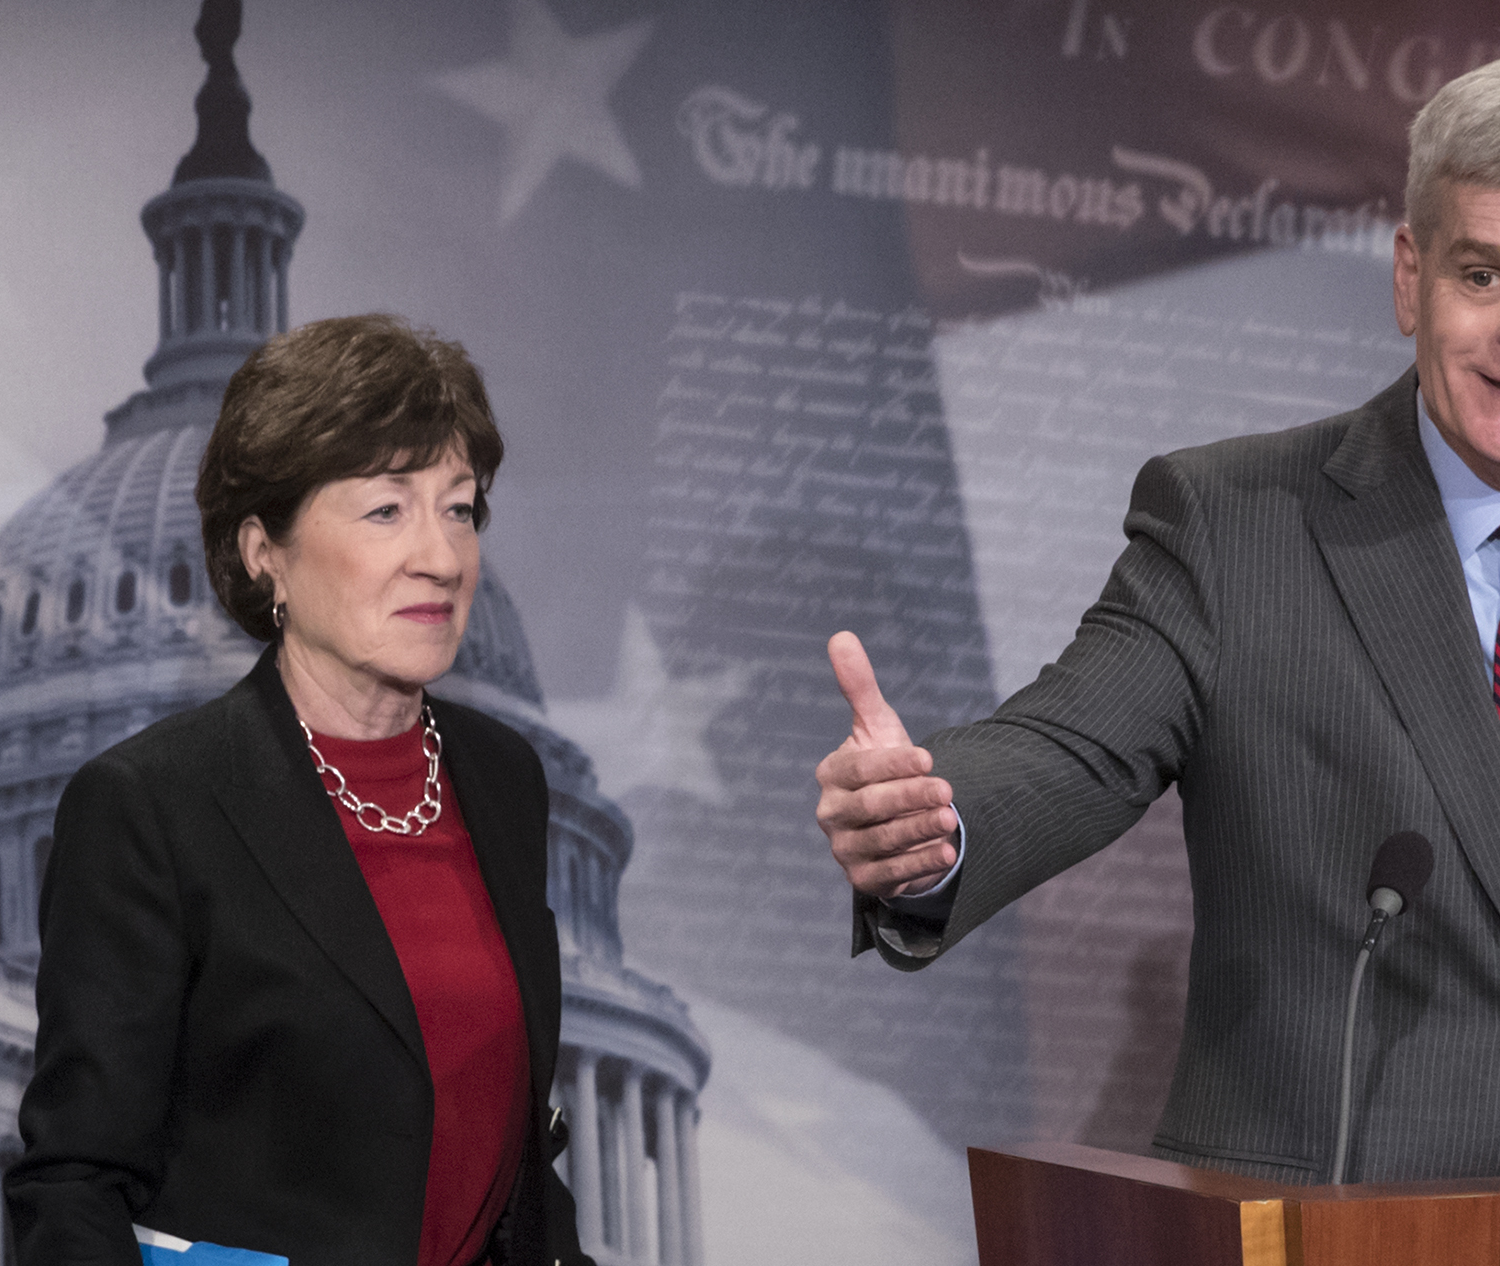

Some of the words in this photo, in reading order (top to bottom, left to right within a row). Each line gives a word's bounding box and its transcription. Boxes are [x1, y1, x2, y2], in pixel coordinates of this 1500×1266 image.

[676, 83, 820, 193] The
[832, 145, 1146, 230] unanimous
[1111, 144, 1395, 258] Declarati
